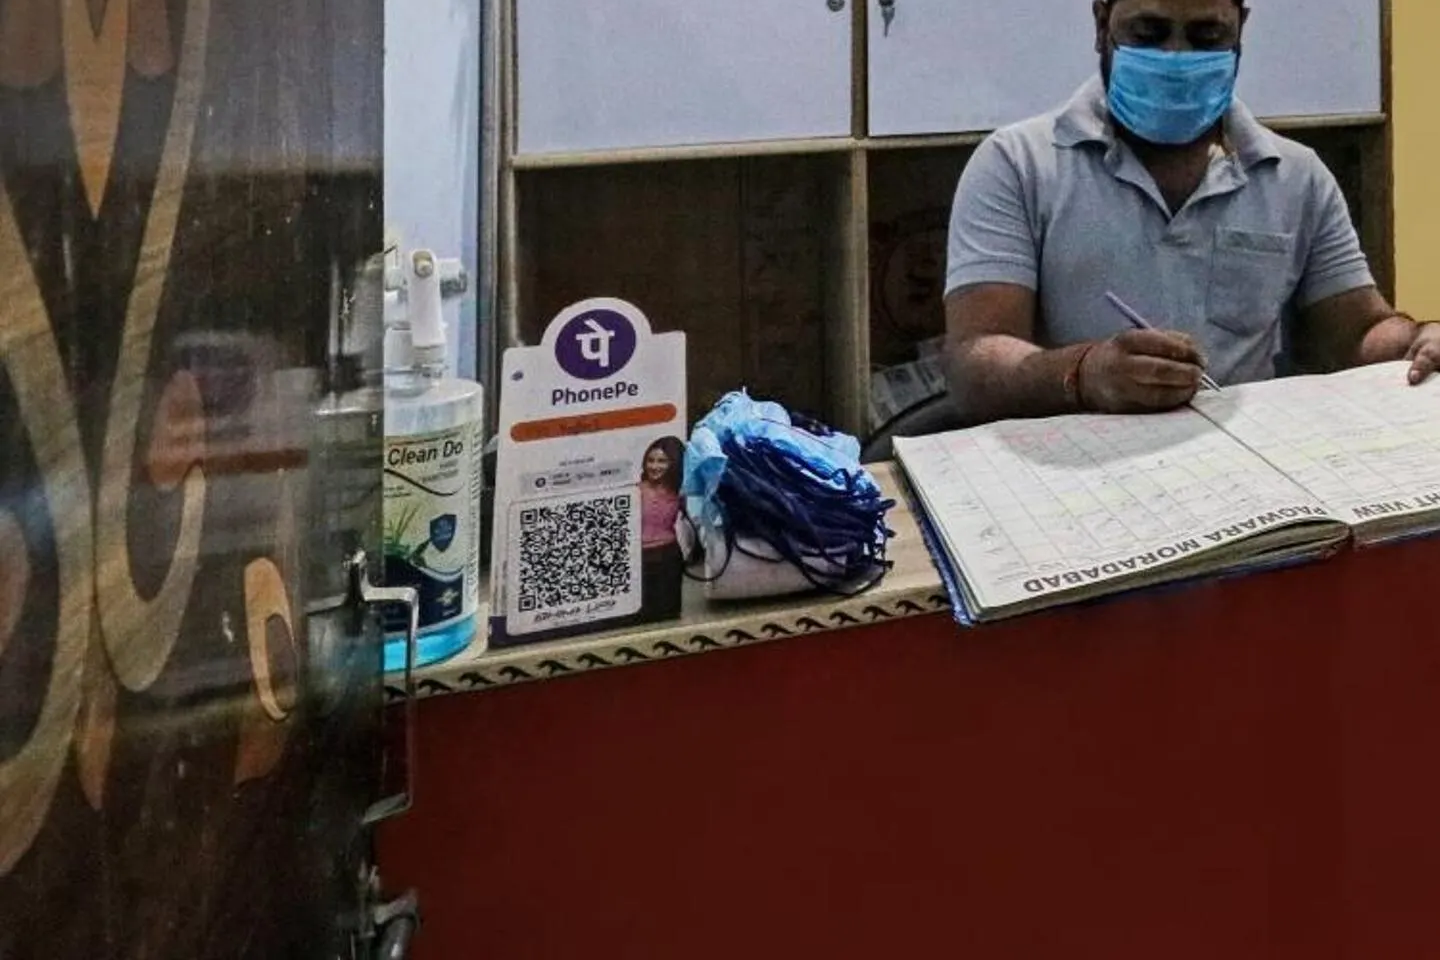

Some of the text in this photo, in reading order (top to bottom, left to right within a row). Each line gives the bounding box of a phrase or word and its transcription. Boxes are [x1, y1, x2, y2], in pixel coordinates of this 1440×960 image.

[552, 381, 639, 406] PhonePe
[388, 447, 438, 466] Clean
[1351, 501, 1411, 519] VIEW
[1023, 538, 1202, 593] MORADABAD
